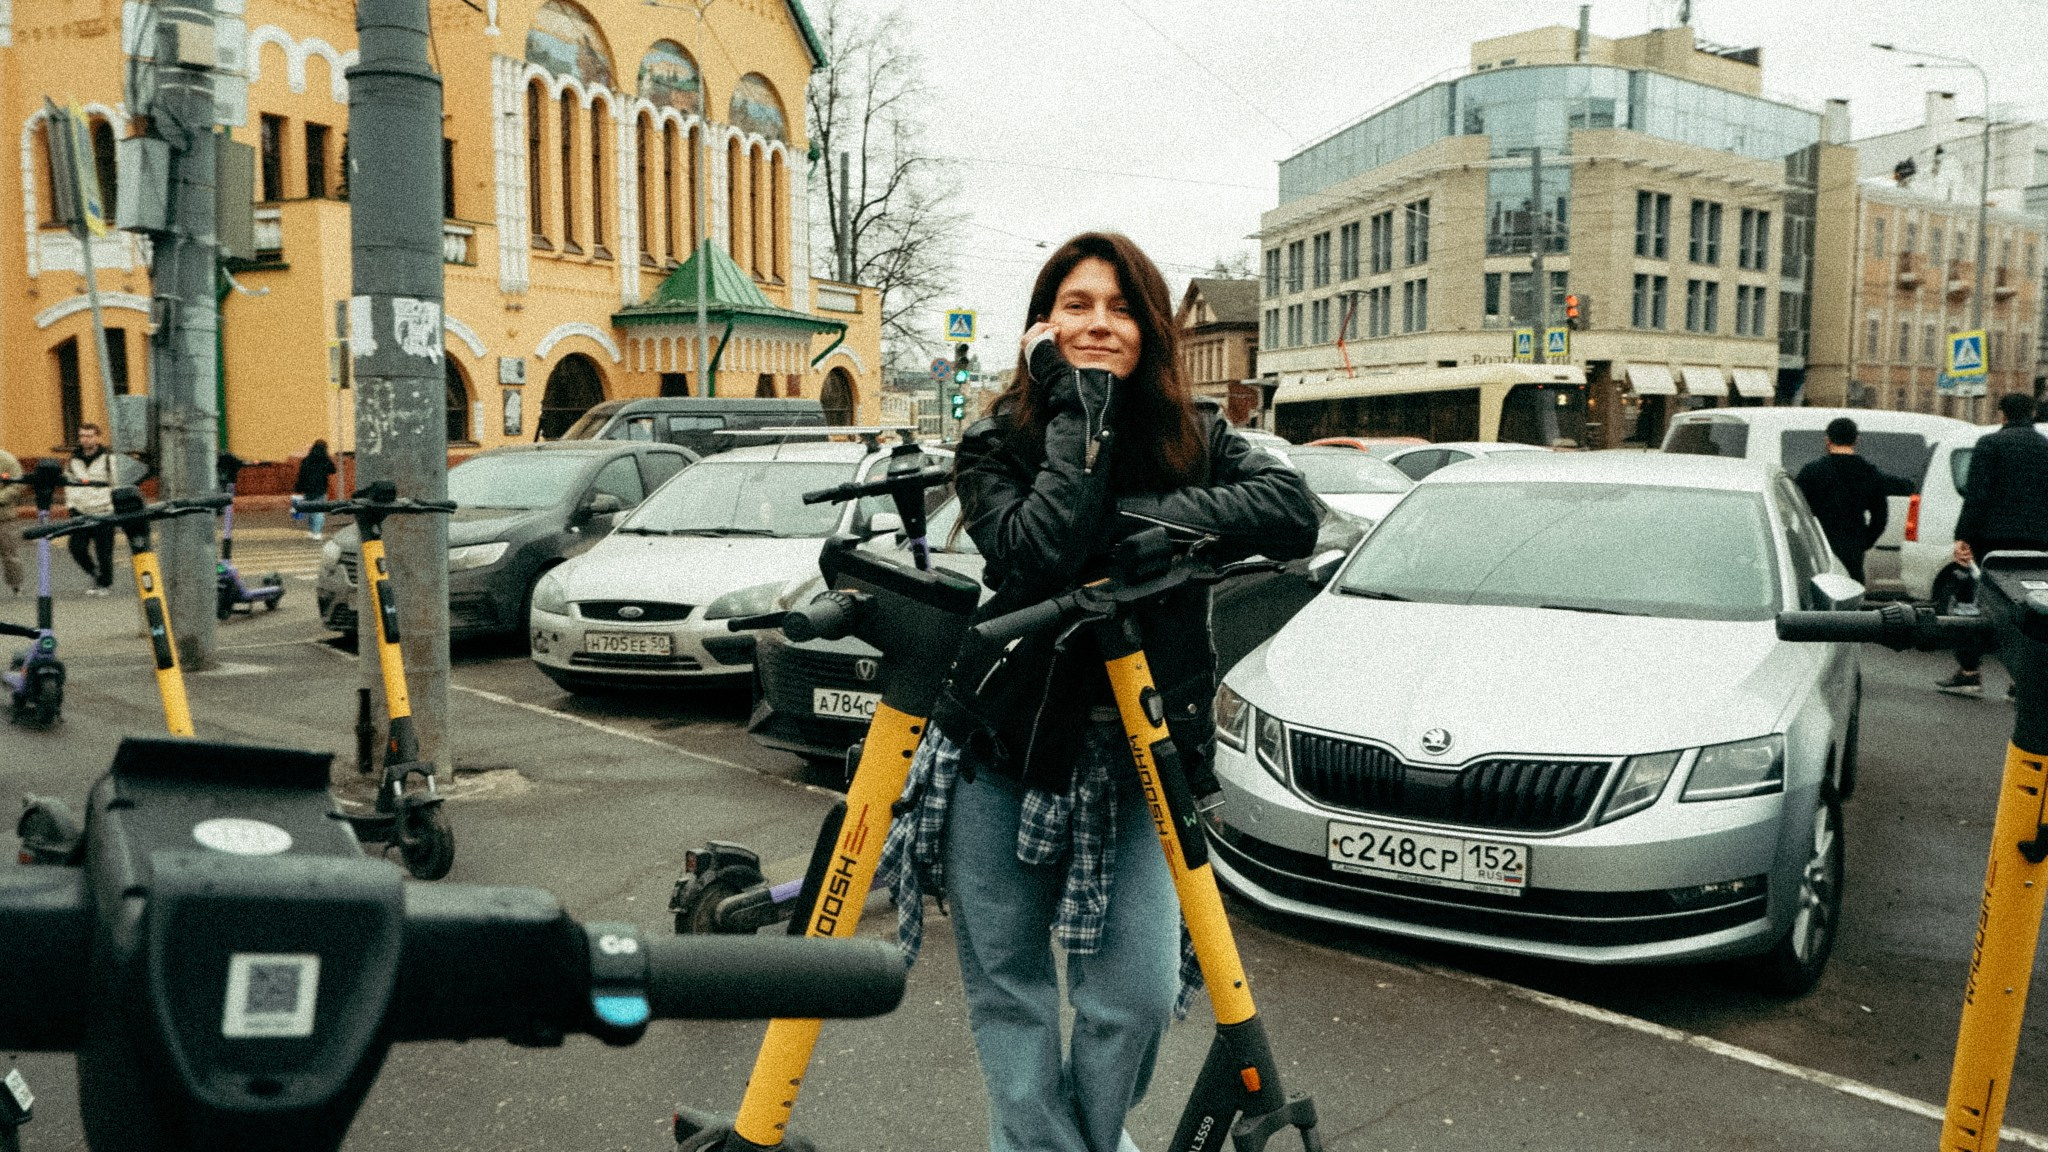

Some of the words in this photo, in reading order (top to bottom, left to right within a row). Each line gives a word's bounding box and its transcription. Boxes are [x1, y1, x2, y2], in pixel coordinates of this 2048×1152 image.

[591, 636, 647, 652] Н705ЕЕ
[819, 692, 875, 716] А784С
[1338, 831, 1458, 872] С248СР
[1468, 844, 1517, 872] 152
[1478, 869, 1503, 881] RUS
[814, 855, 857, 937] OOSH
[1188, 1115, 1215, 1152] L3559
